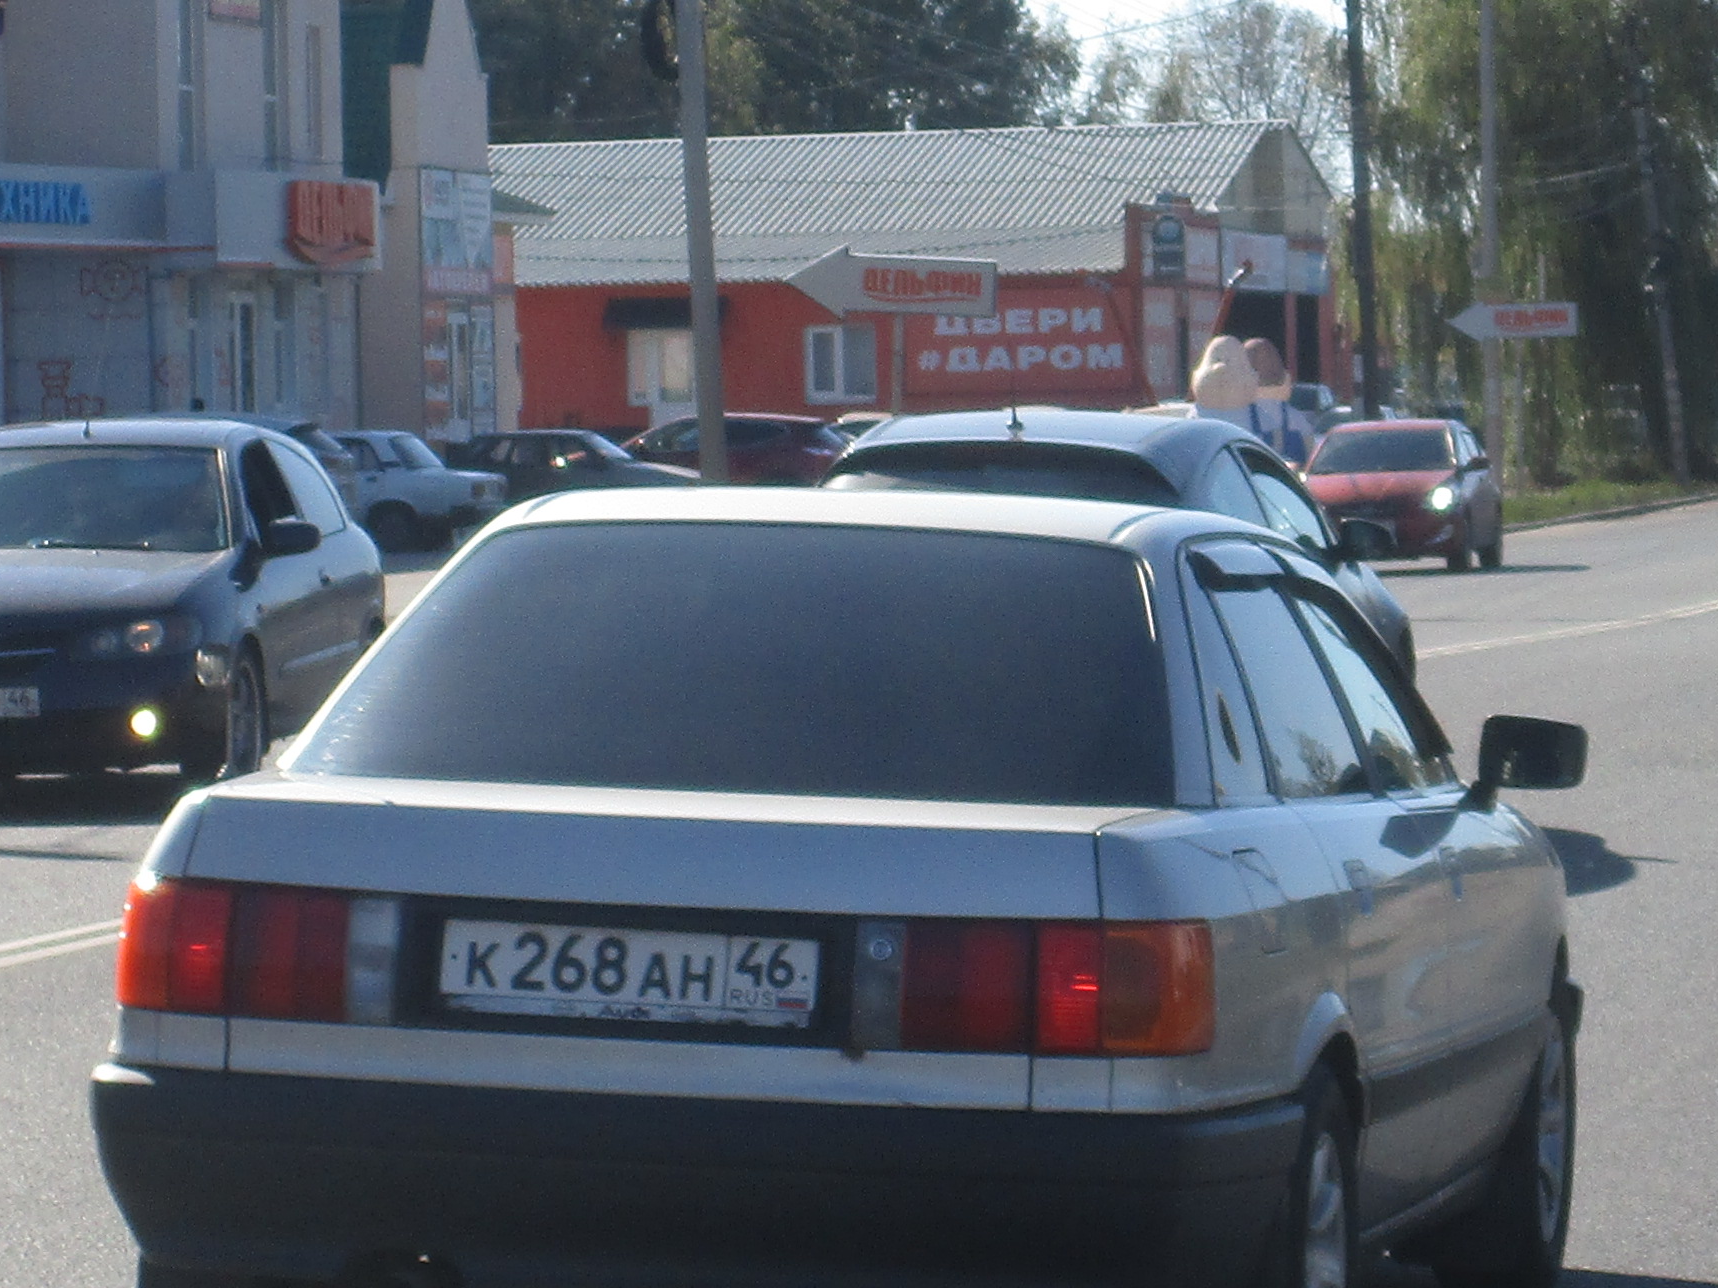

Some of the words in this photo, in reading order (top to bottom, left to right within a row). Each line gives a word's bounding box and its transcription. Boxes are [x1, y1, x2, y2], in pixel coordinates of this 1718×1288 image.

[934, 307, 1104, 336] ДВЕРИ
[917, 343, 1125, 373] #ДАРОМ
[734, 939, 796, 989] 46
[729, 989, 775, 1007] RUS
